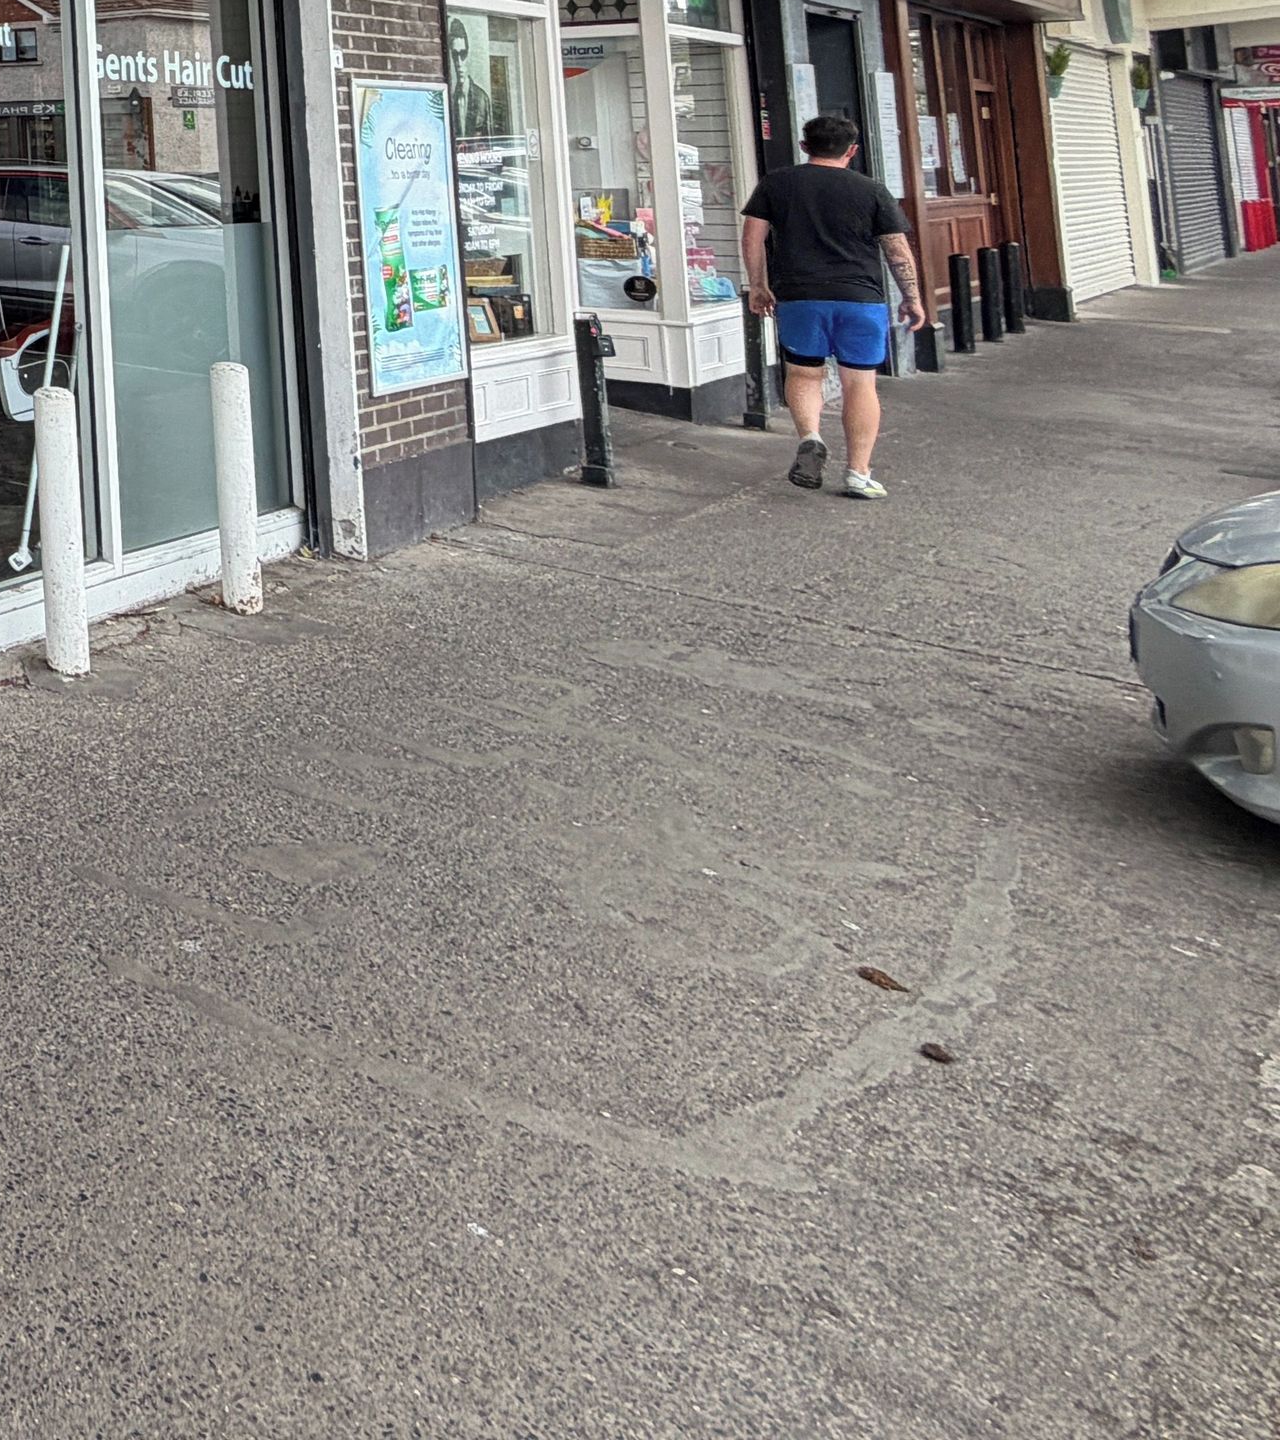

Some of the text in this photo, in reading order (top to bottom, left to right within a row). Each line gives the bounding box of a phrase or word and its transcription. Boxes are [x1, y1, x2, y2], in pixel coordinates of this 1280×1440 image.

[561, 44, 604, 57] oltarol
[163, 49, 213, 87] Hair
[216, 55, 254, 91] Cut
[385, 137, 432, 165] Clearing
